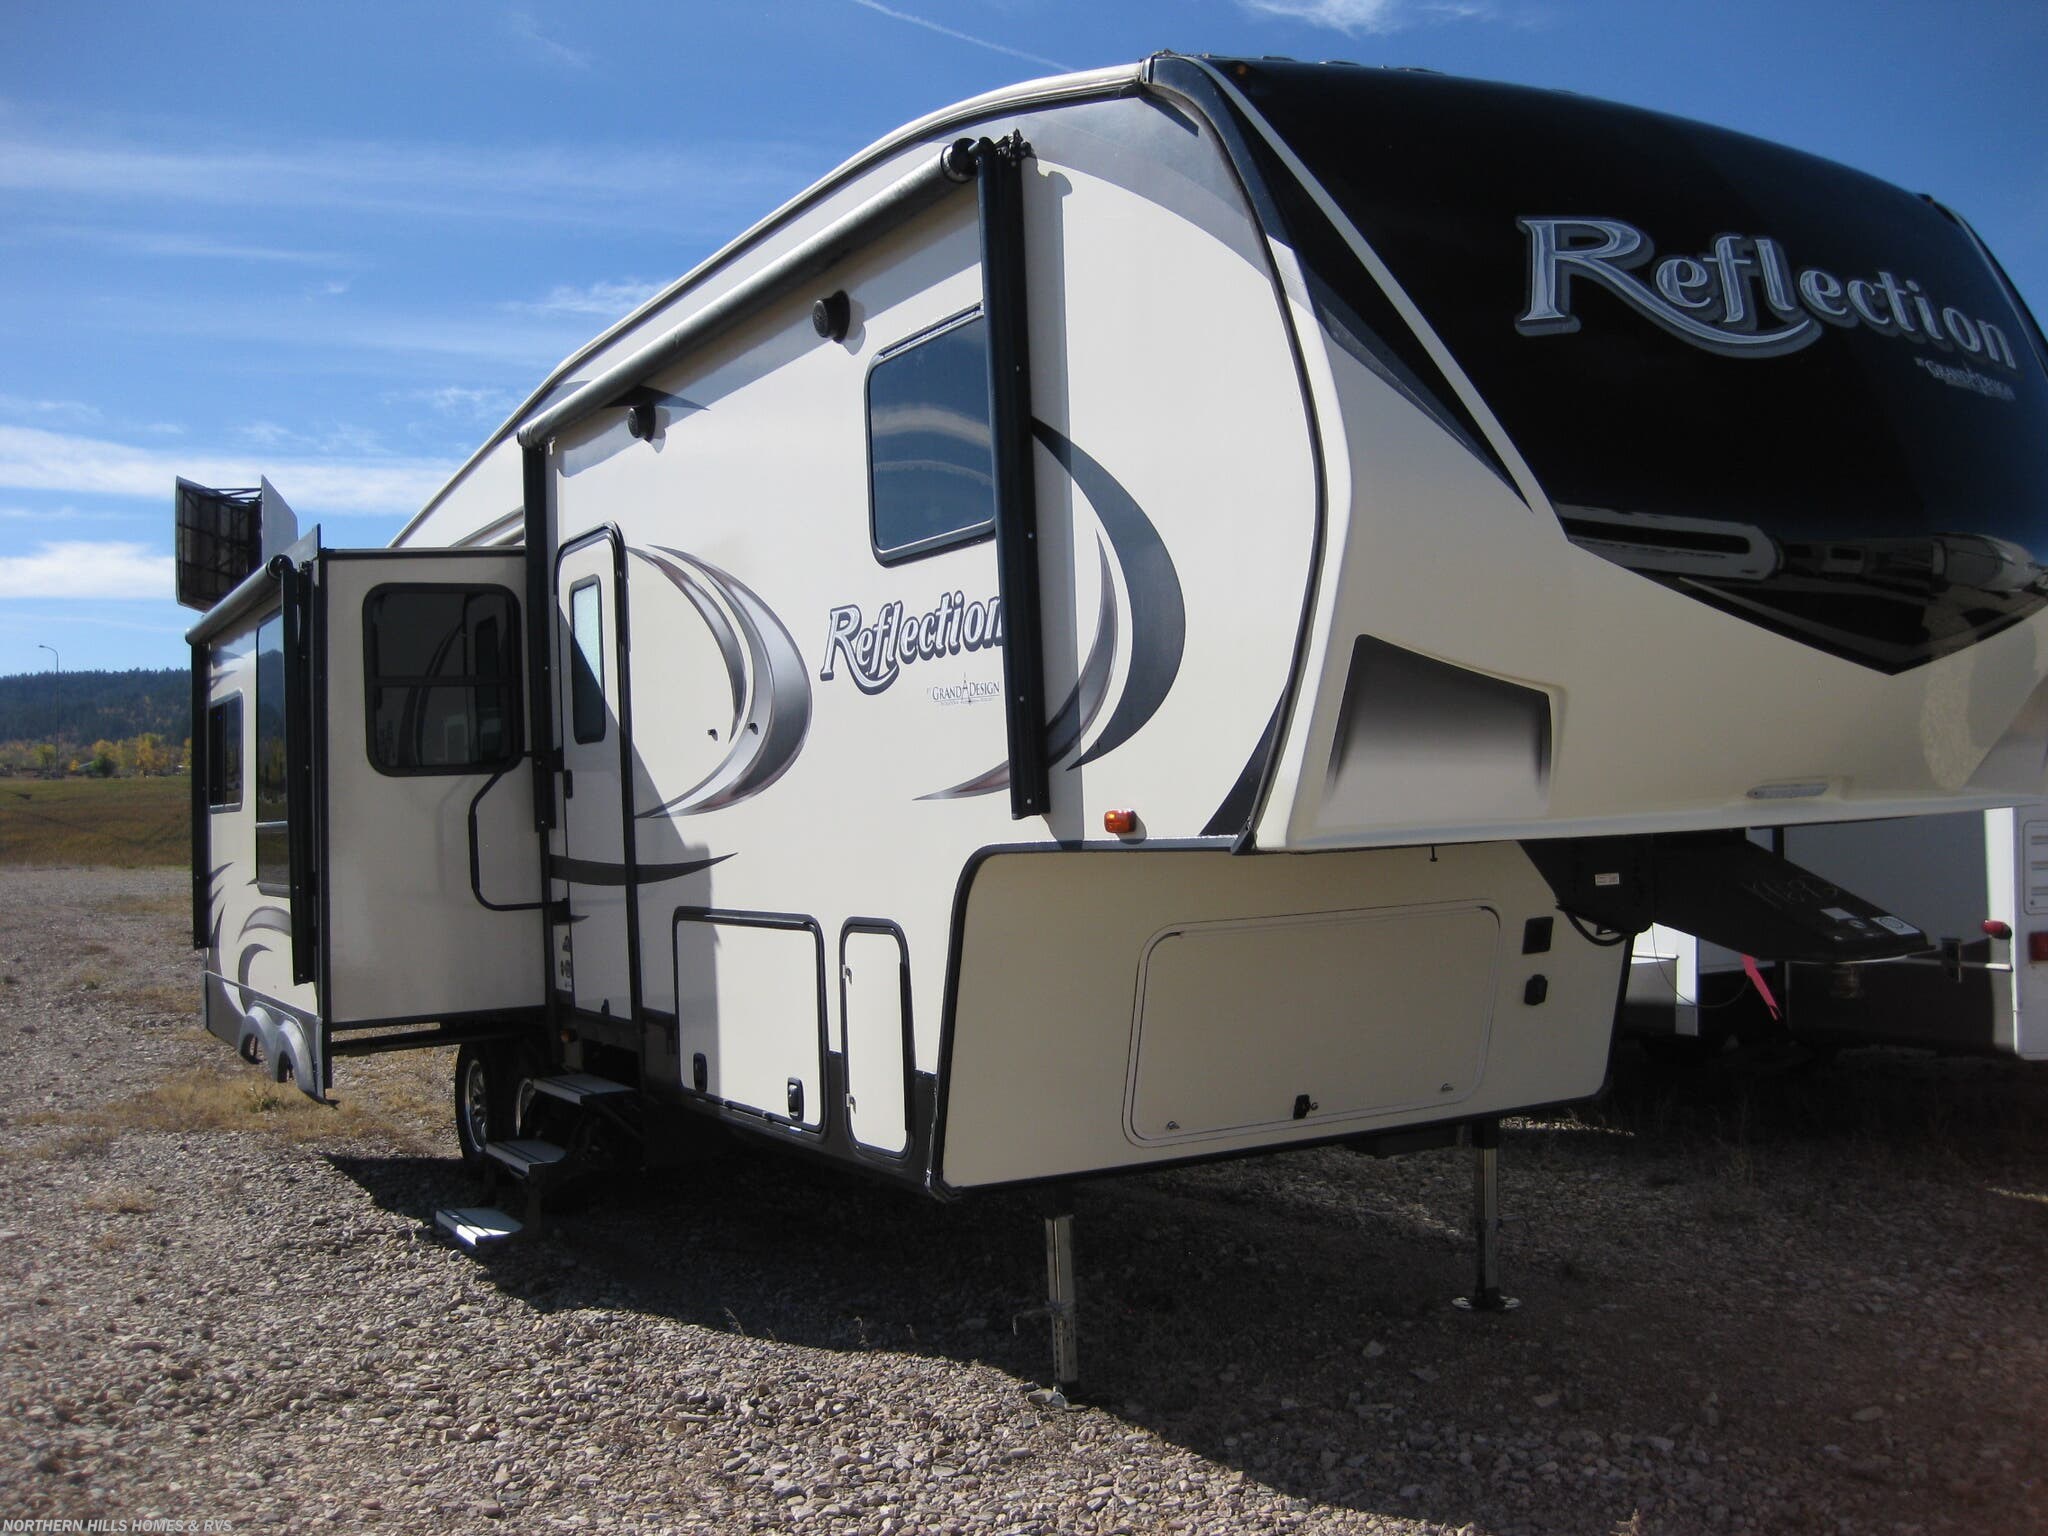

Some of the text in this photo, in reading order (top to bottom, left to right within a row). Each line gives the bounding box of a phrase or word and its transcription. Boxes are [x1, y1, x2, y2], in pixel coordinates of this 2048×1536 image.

[1514, 215, 2018, 369] Reflection
[819, 590, 1003, 696] Reflection
[932, 681, 1000, 700] GRAND DESIGN
